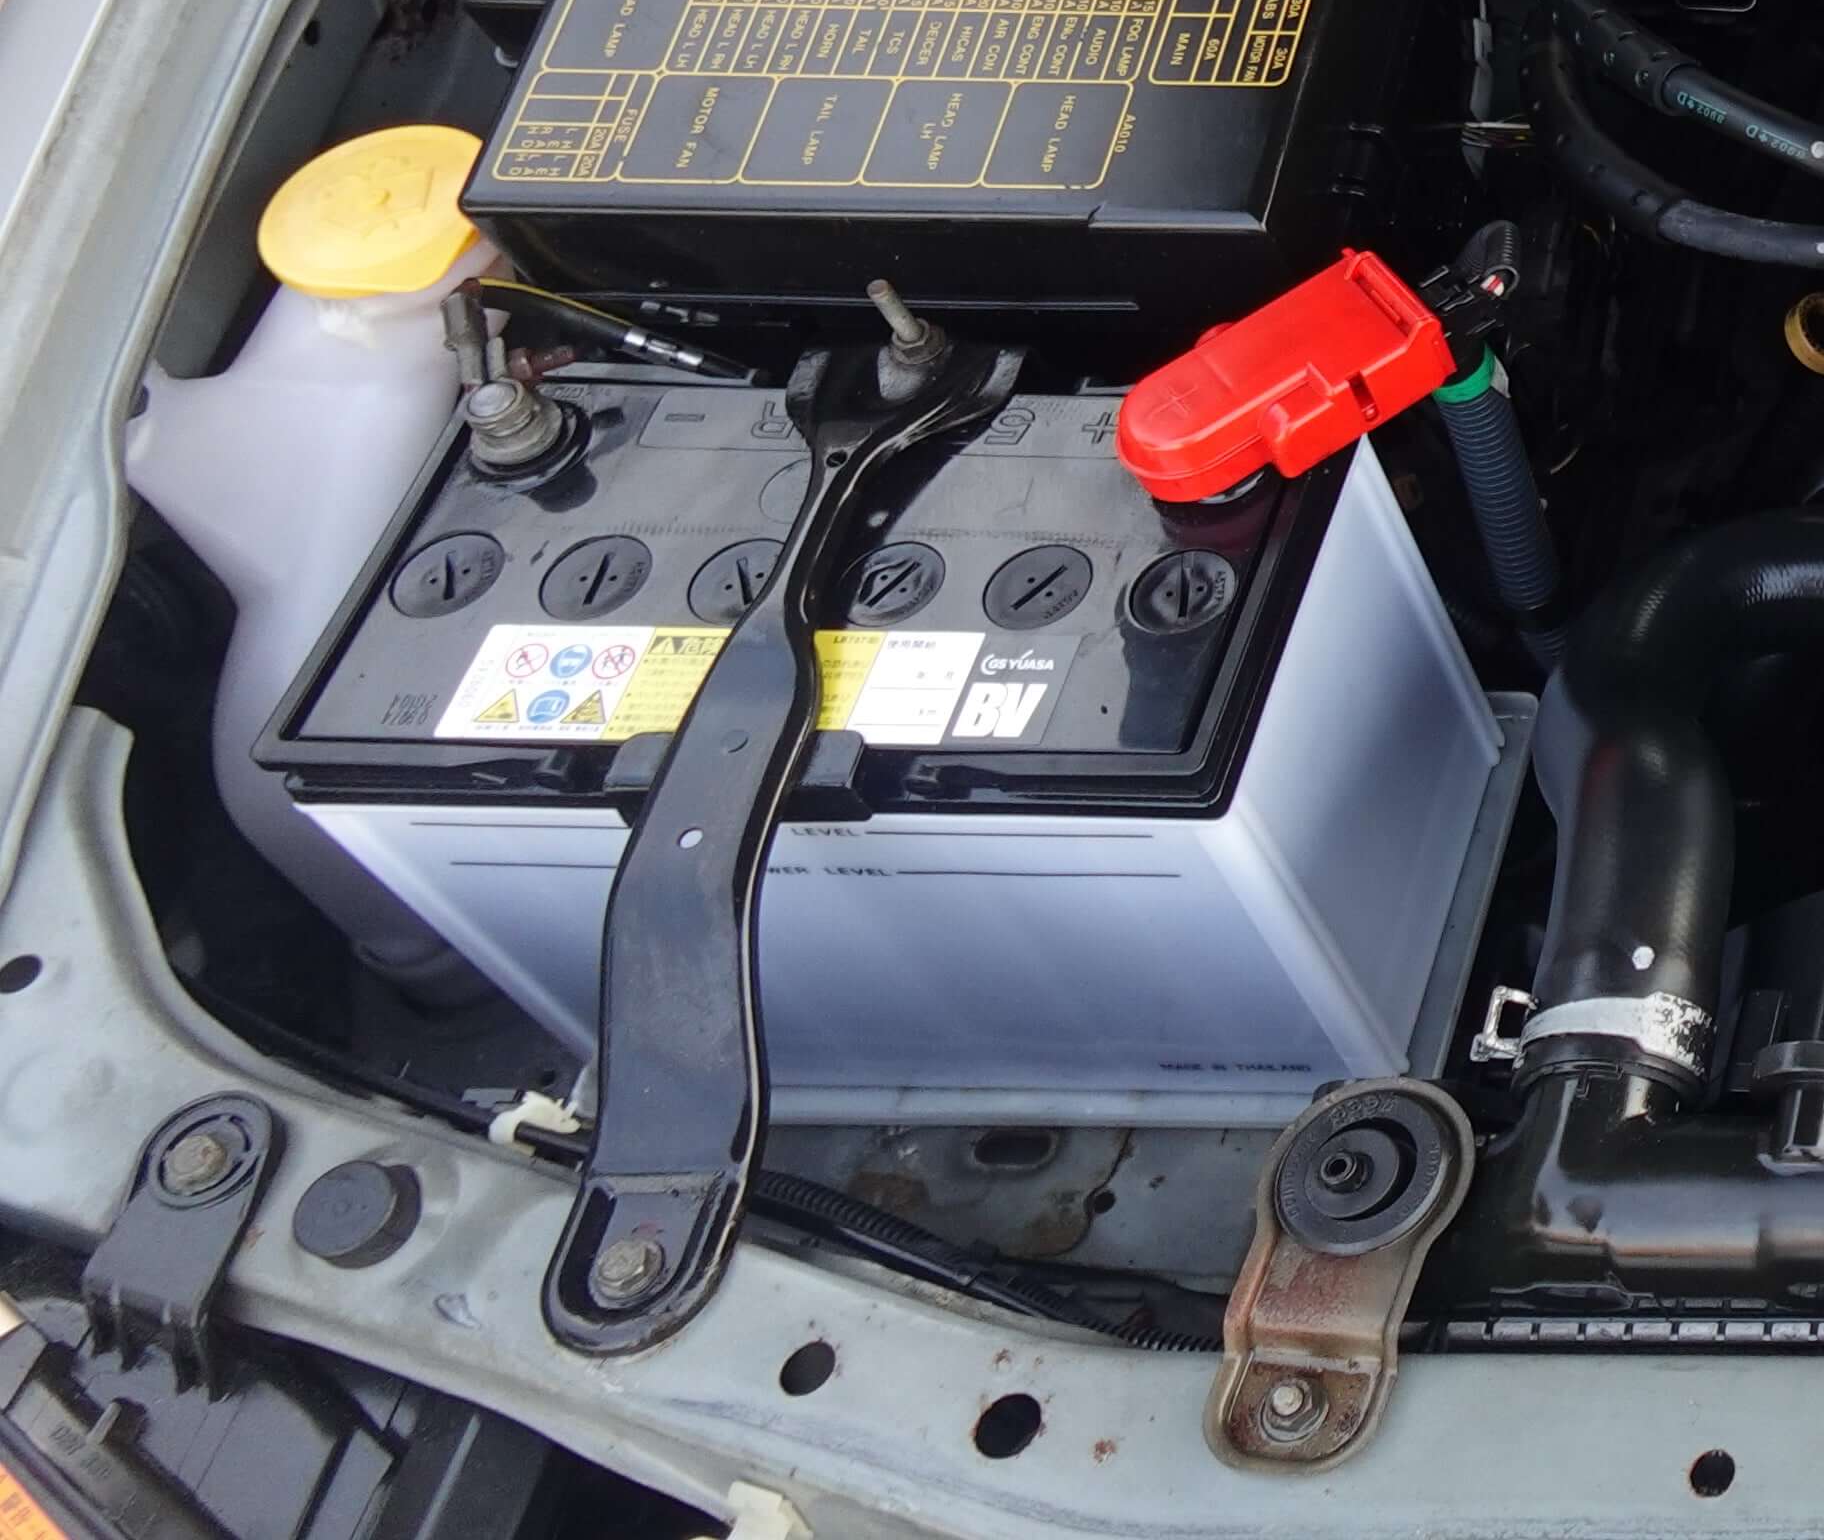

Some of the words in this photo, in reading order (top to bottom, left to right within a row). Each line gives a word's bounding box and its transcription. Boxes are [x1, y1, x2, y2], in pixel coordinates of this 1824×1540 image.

[688, 9, 709, 38] HEAD
[722, 10, 744, 38] HEAD
[756, 10, 776, 39] HEAD
[791, 11, 811, 39] HEAD
[998, 18, 1010, 38] AIR
[1027, 16, 1044, 40] ENG
[1060, 17, 1078, 40] ENG
[1128, 18, 1144, 42] FOG
[603, 23, 625, 58] LAMP
[816, 23, 840, 59] HORN
[852, 29, 872, 53] TAIL
[886, 30, 906, 55] TCS
[952, 26, 974, 62] HICAS
[1086, 27, 1106, 66] AUDIO
[1170, 32, 1191, 66] MAIN
[1204, 38, 1220, 60] 60A
[675, 54, 690, 68] LH
[709, 53, 726, 69] RH
[744, 55, 759, 69] LH
[778, 55, 794, 71] RH
[982, 45, 1000, 71] CON
[1016, 44, 1034, 76] CONT
[1048, 45, 1068, 76] CONT
[1116, 47, 1133, 77] LAMP
[1272, 47, 1288, 69] 30A
[690, 87, 720, 134] MOTOR
[816, 94, 838, 122] TAIL
[941, 92, 964, 128] HEAD
[1054, 95, 1076, 130] HEAD
[589, 128, 607, 149] 20A
[614, 108, 638, 143] FUSE
[920, 123, 936, 140] LH
[675, 141, 697, 168] FAN
[801, 130, 824, 165] LAMP
[927, 136, 947, 170] LAMP
[1040, 138, 1061, 173] LAMP
[577, 155, 595, 176] 20A
[1009, 649, 1055, 671] YUASA
[951, 682, 1048, 738] BV
[791, 827, 860, 837] LEVEL
[823, 867, 892, 877] LEVEL
